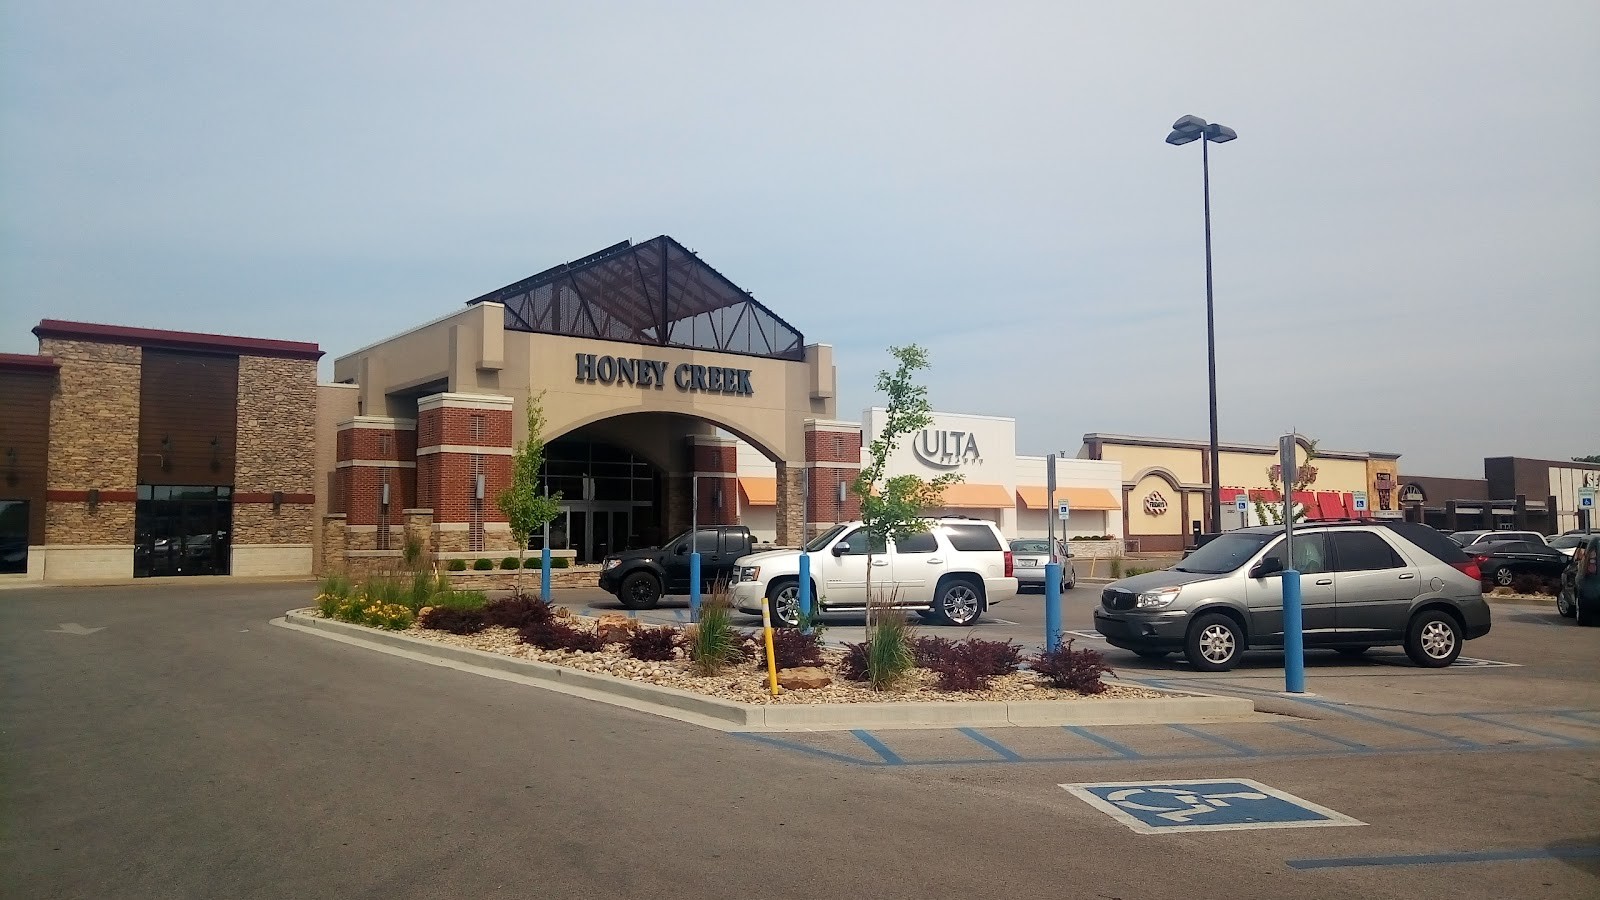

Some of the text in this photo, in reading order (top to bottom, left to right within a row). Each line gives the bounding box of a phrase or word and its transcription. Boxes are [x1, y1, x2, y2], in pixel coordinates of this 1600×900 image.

[575, 353, 754, 396] HONEY CREEK
[922, 429, 980, 459] ULTA
